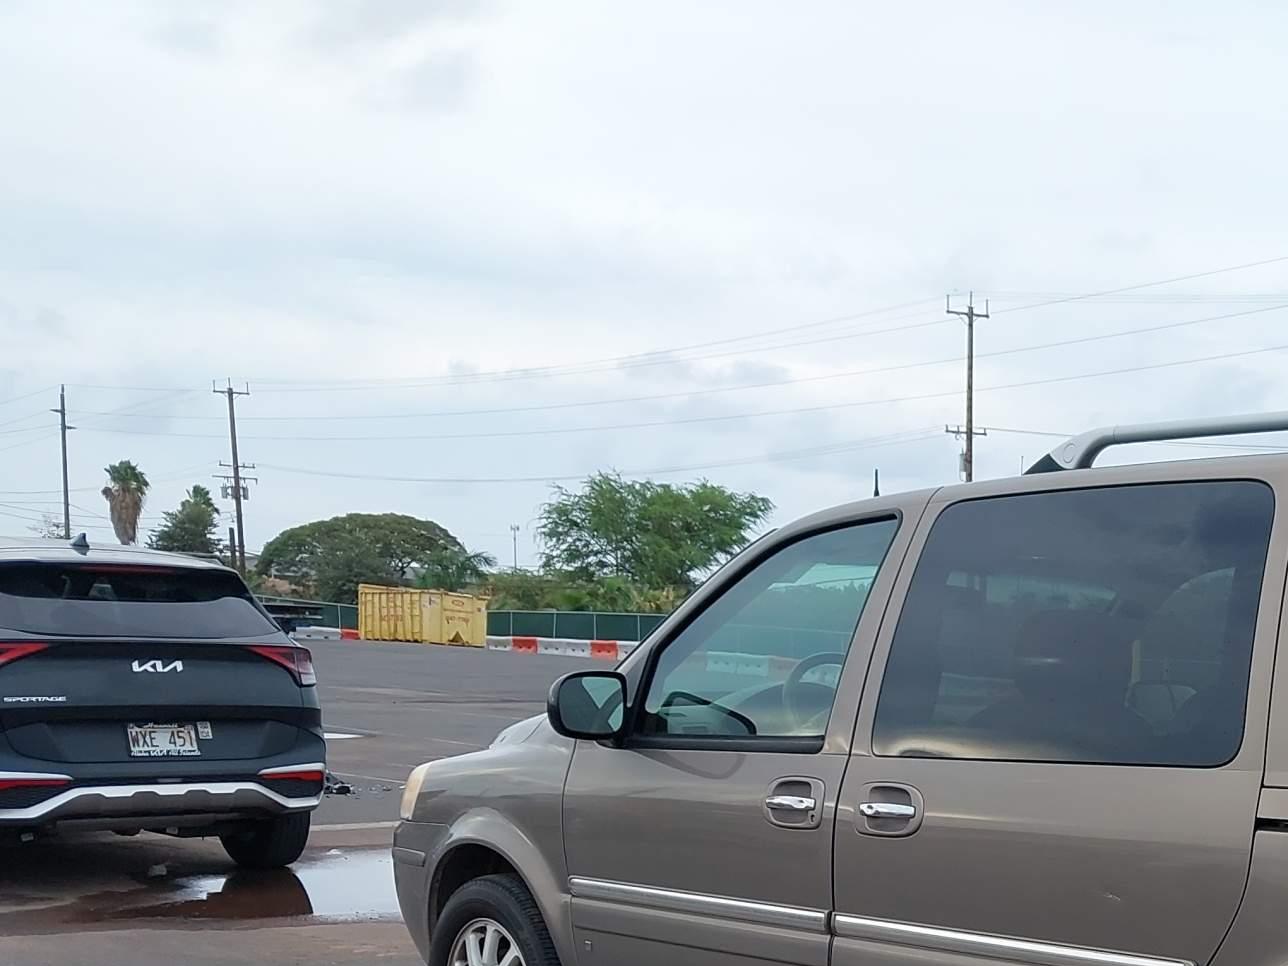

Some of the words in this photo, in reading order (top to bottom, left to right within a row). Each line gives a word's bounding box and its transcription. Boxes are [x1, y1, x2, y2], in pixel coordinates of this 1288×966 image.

[131, 659, 184, 673] KIA
[129, 730, 160, 748] WXE
[168, 730, 195, 748] 451
